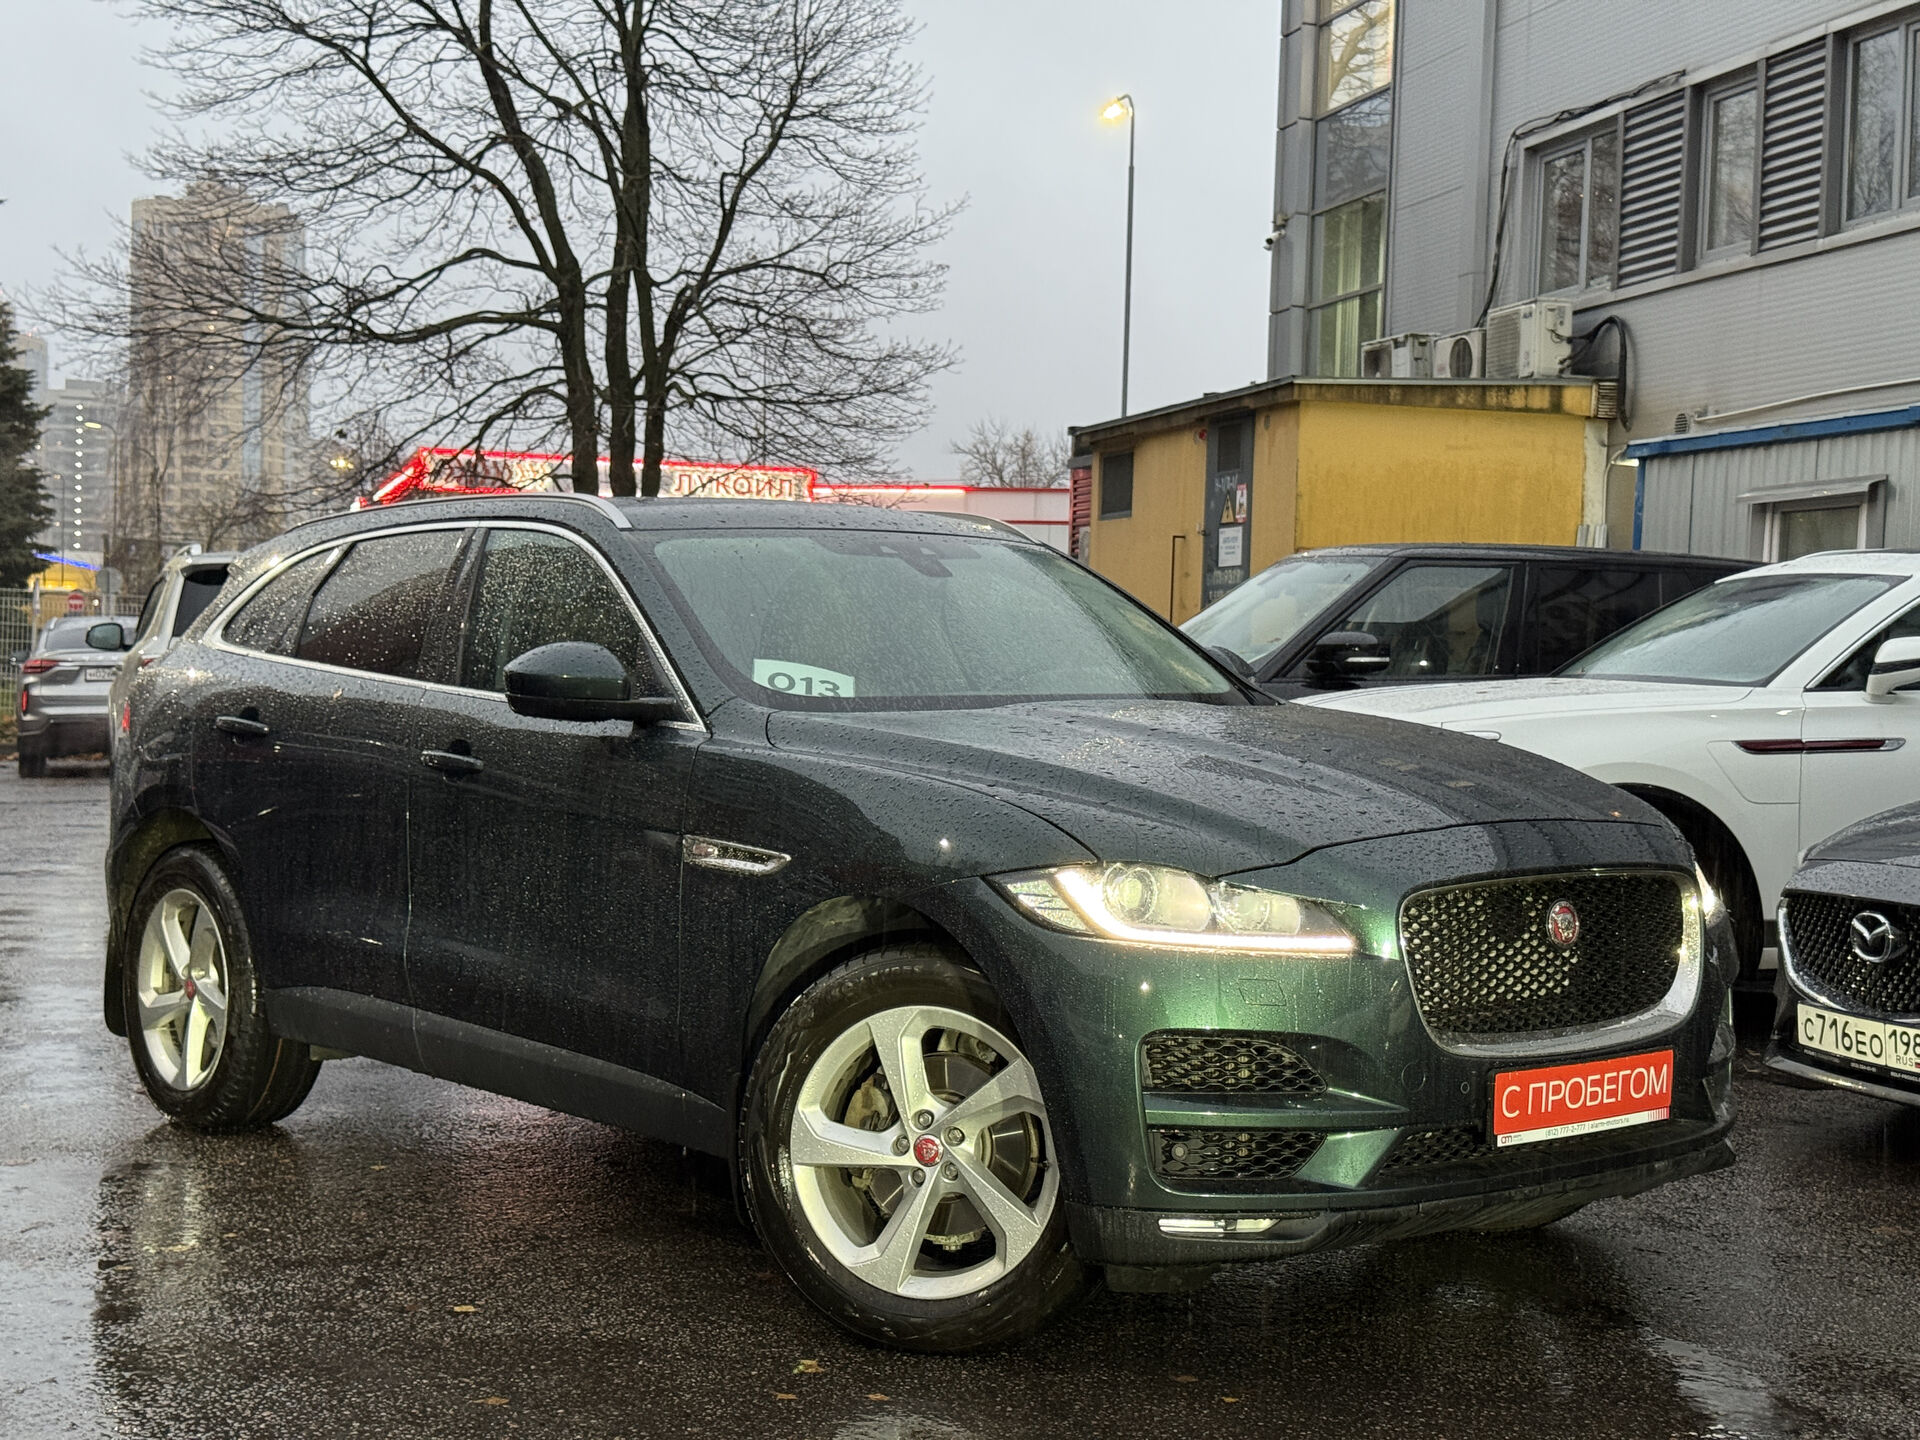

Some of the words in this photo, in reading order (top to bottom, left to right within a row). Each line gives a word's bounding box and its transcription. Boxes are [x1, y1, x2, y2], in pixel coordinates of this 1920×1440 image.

[767, 672, 841, 697] 013
[1804, 1013, 1883, 1058] С716ЕО
[1896, 1054, 1914, 1067] RUS
[1502, 1085, 1521, 1118] С
[1528, 1063, 1668, 1115] ПРОБЕГОМ
